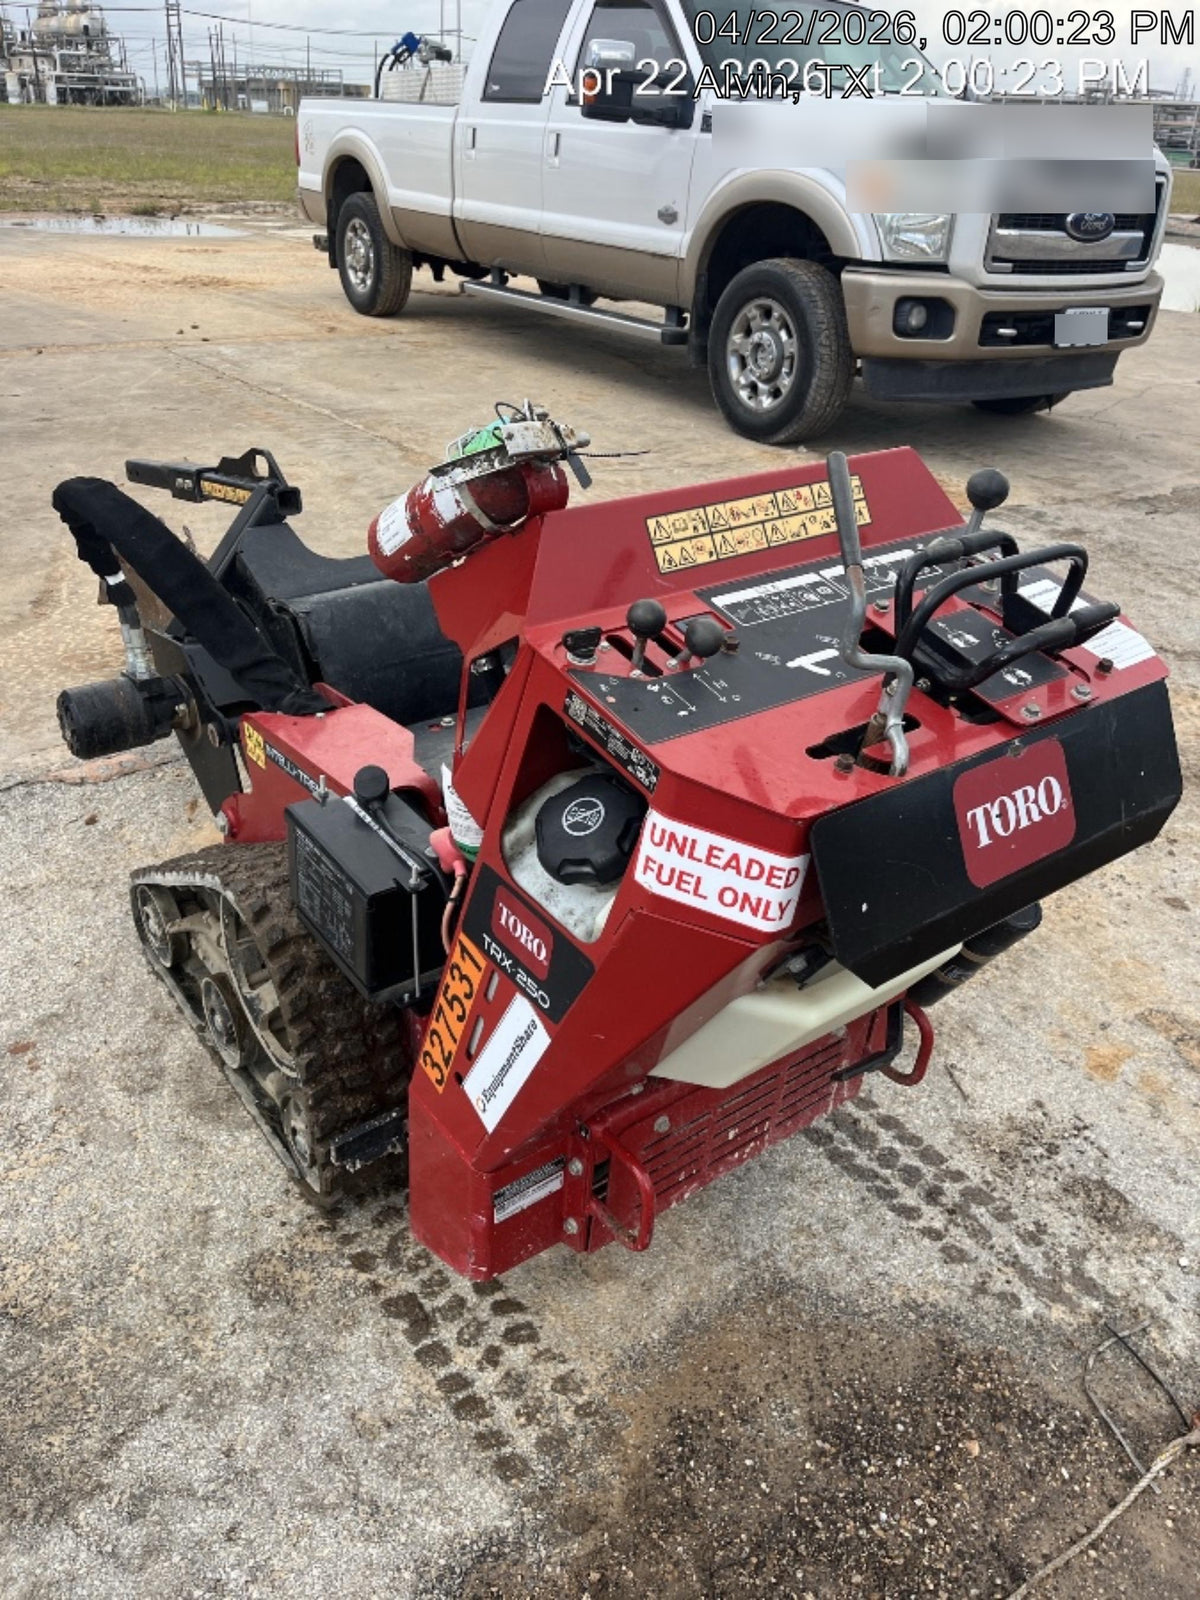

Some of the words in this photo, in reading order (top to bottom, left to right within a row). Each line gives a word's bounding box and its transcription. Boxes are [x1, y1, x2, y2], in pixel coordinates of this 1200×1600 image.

[966, 776, 1062, 849] TORO
[642, 854, 708, 900] FUEL
[717, 886, 794, 922] ONLY
[650, 822, 800, 889] UNLEADED
[498, 902, 547, 962] TORO
[482, 932, 551, 1009] TRX-250
[422, 938, 483, 1087] 327531
[481, 1018, 538, 1104] EquipmentShare
